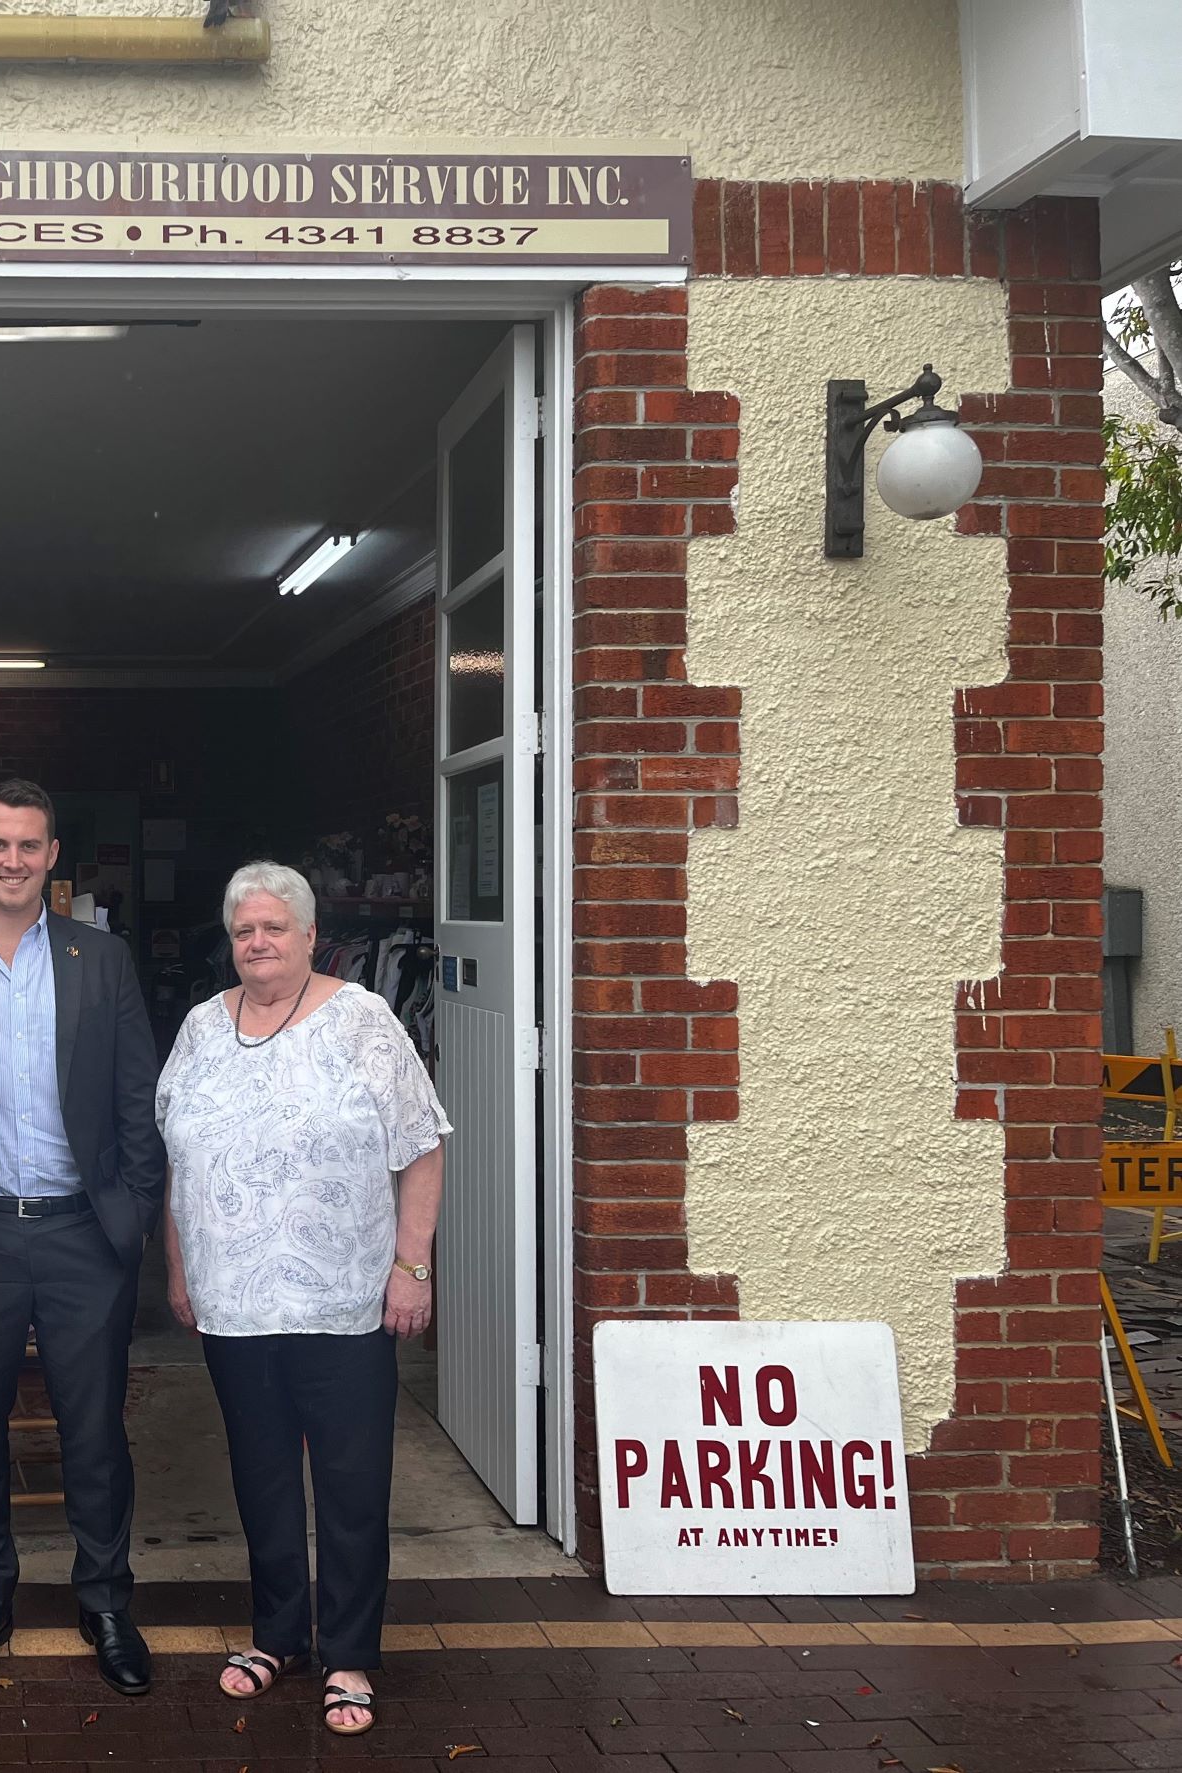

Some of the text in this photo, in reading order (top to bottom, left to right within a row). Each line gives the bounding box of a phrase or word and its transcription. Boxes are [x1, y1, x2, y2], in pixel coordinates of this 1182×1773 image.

[330, 162, 530, 206] SERVICE
[546, 164, 629, 207] INC.
[161, 224, 244, 245] Ph.
[264, 226, 386, 245] 4341
[411, 227, 538, 246] 8837
[1102, 1157, 1182, 1192] TER
[699, 1364, 798, 1427] NO
[615, 1438, 897, 1510] PARKING!
[678, 1528, 839, 1547] AT ANYTIME!
